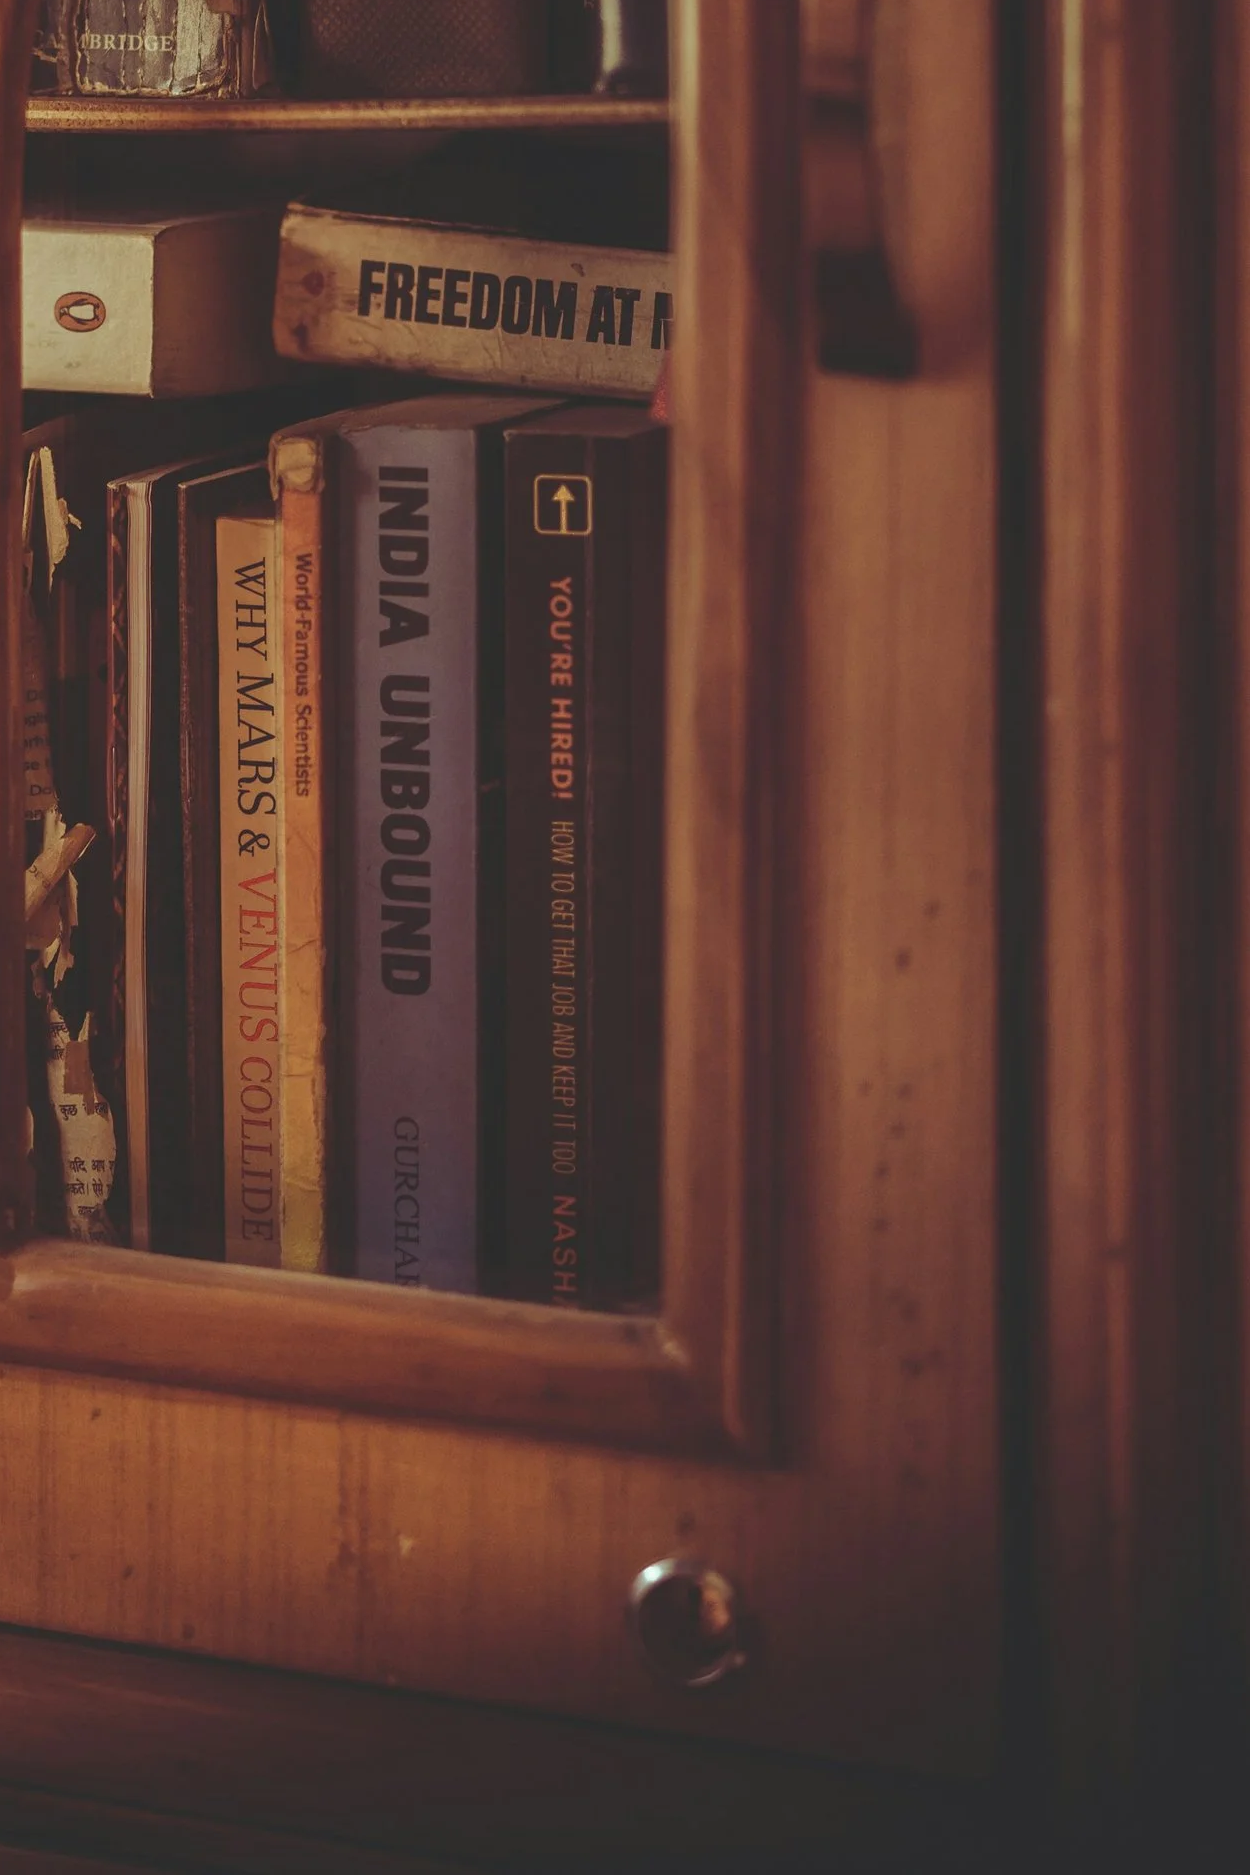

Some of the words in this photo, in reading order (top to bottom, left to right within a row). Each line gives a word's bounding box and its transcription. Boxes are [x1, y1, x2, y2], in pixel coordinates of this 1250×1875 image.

[357, 259, 578, 341] FREEDOM
[586, 285, 641, 347] AT
[379, 466, 430, 648] INDIA
[235, 557, 268, 661] WHY
[295, 553, 314, 697] World-Famous
[549, 576, 573, 687] YOU'RE
[236, 674, 276, 816] MARS
[295, 703, 313, 798] Scientists
[550, 698, 574, 800] HIRED!
[237, 829, 271, 857] &
[380, 675, 431, 996] UNBOUND
[551, 820, 575, 864] HOW
[551, 872, 575, 893] TO
[551, 899, 575, 933] GET
[238, 868, 279, 1042] VENUS
[552, 939, 576, 977] THAT
[552, 982, 576, 1016] JOB
[552, 1022, 576, 1059] AND
[552, 1065, 576, 1107] KEEP
[240, 1056, 274, 1242] COLLIDE
[552, 1113, 576, 1131] IT
[552, 1140, 576, 1175] TOO
[552, 1195, 577, 1307] NASH
